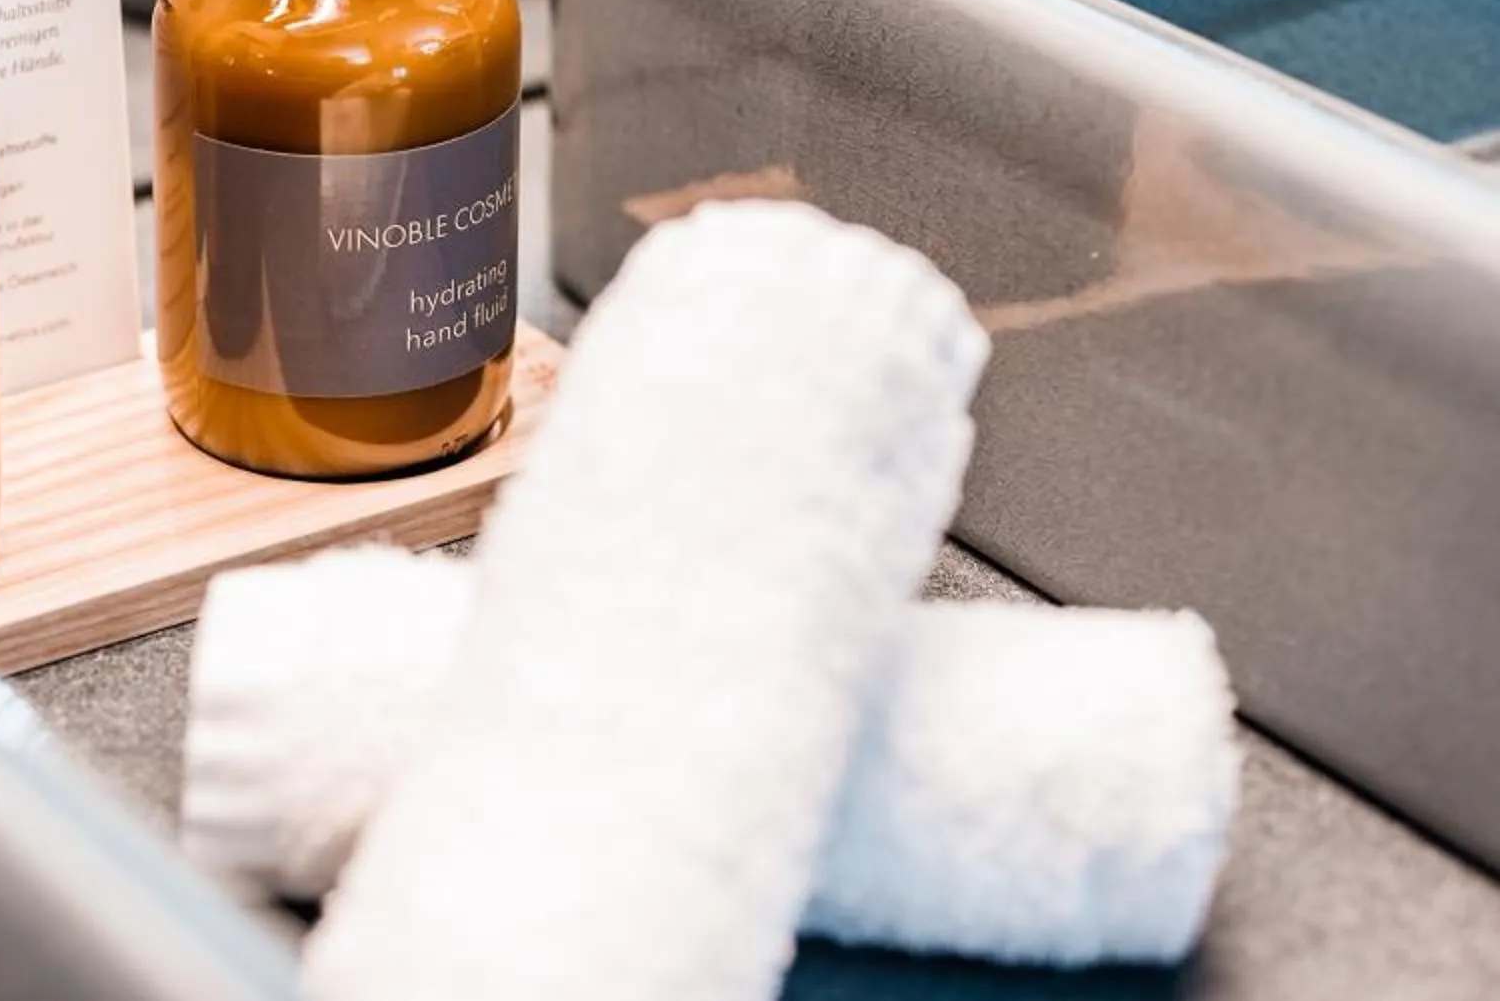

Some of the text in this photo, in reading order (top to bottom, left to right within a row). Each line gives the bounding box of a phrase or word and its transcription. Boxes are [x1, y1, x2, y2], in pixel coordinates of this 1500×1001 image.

[326, 174, 515, 254] VINOBLE COSME
[405, 284, 509, 352] hand fluid
[409, 259, 508, 317] hydrating
